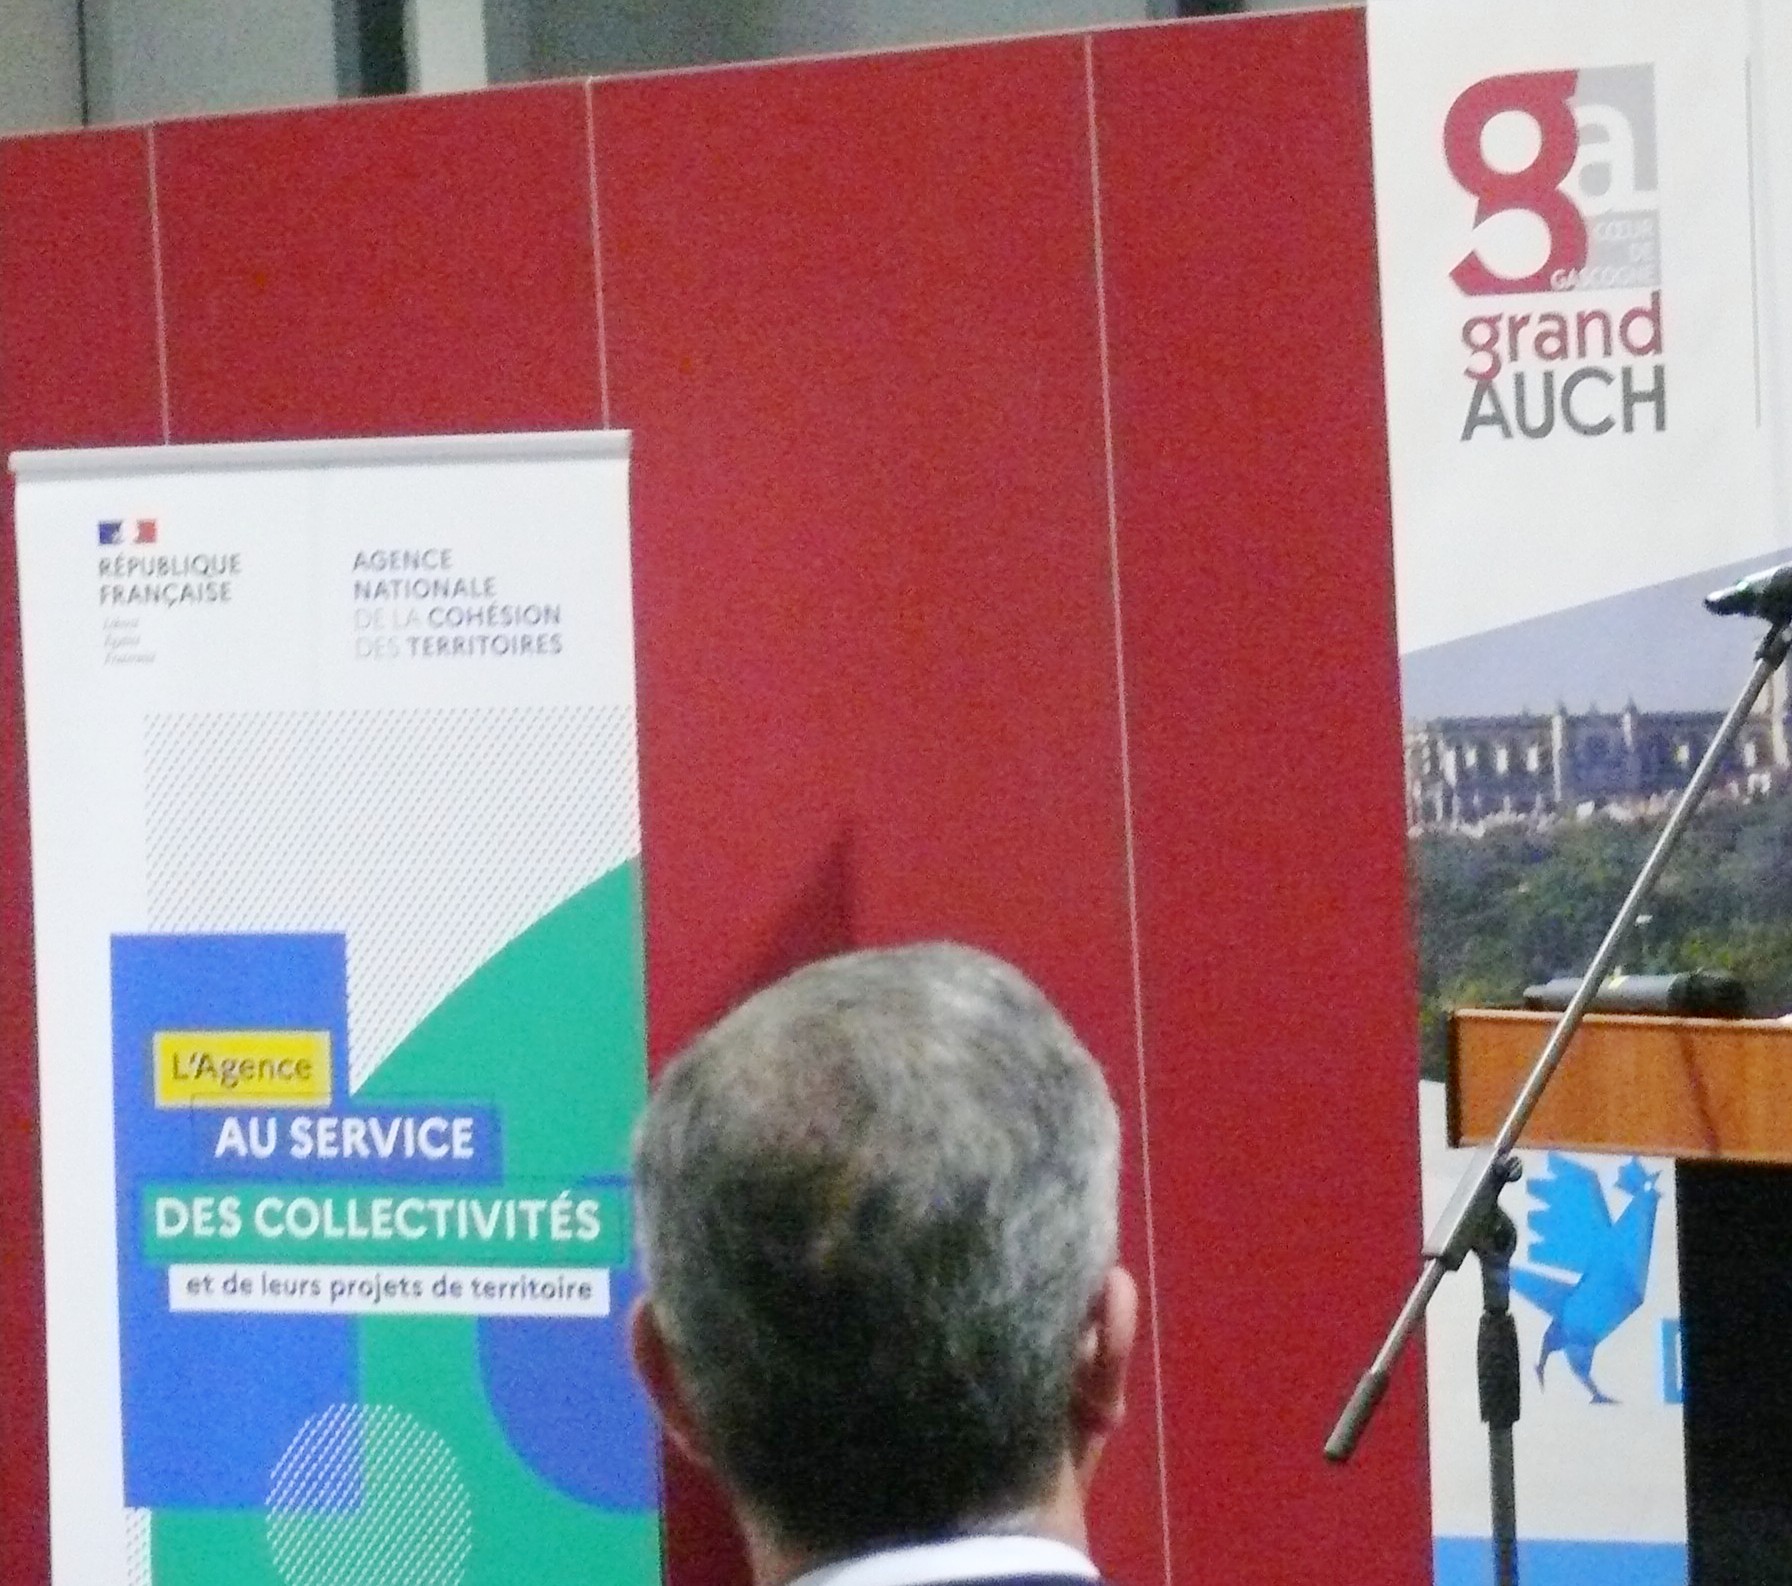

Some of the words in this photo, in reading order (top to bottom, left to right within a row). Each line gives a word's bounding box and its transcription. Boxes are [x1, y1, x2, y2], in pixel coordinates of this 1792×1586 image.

[1461, 290, 1663, 381] grand
[1460, 364, 1667, 442] AUCH
[98, 552, 242, 578] RÉPUBLIQUE
[352, 548, 453, 571] AGENCE
[98, 581, 232, 609] FRANÇAISE
[353, 576, 497, 600] NATIONALE
[427, 600, 561, 629] COHÉSION
[406, 632, 563, 658] TERRITOIRES
[171, 1050, 314, 1088] L'Agence
[214, 1116, 278, 1159] AU
[289, 1116, 475, 1159] SERVICE
[155, 1196, 242, 1239] DES
[253, 1190, 602, 1241] COLLECTIVITÉS
[186, 1273, 216, 1295] et
[222, 1271, 254, 1296] de
[261, 1272, 322, 1298] leurs
[330, 1274, 424, 1305] projets
[431, 1273, 465, 1298] de
[470, 1275, 593, 1300] territoire
